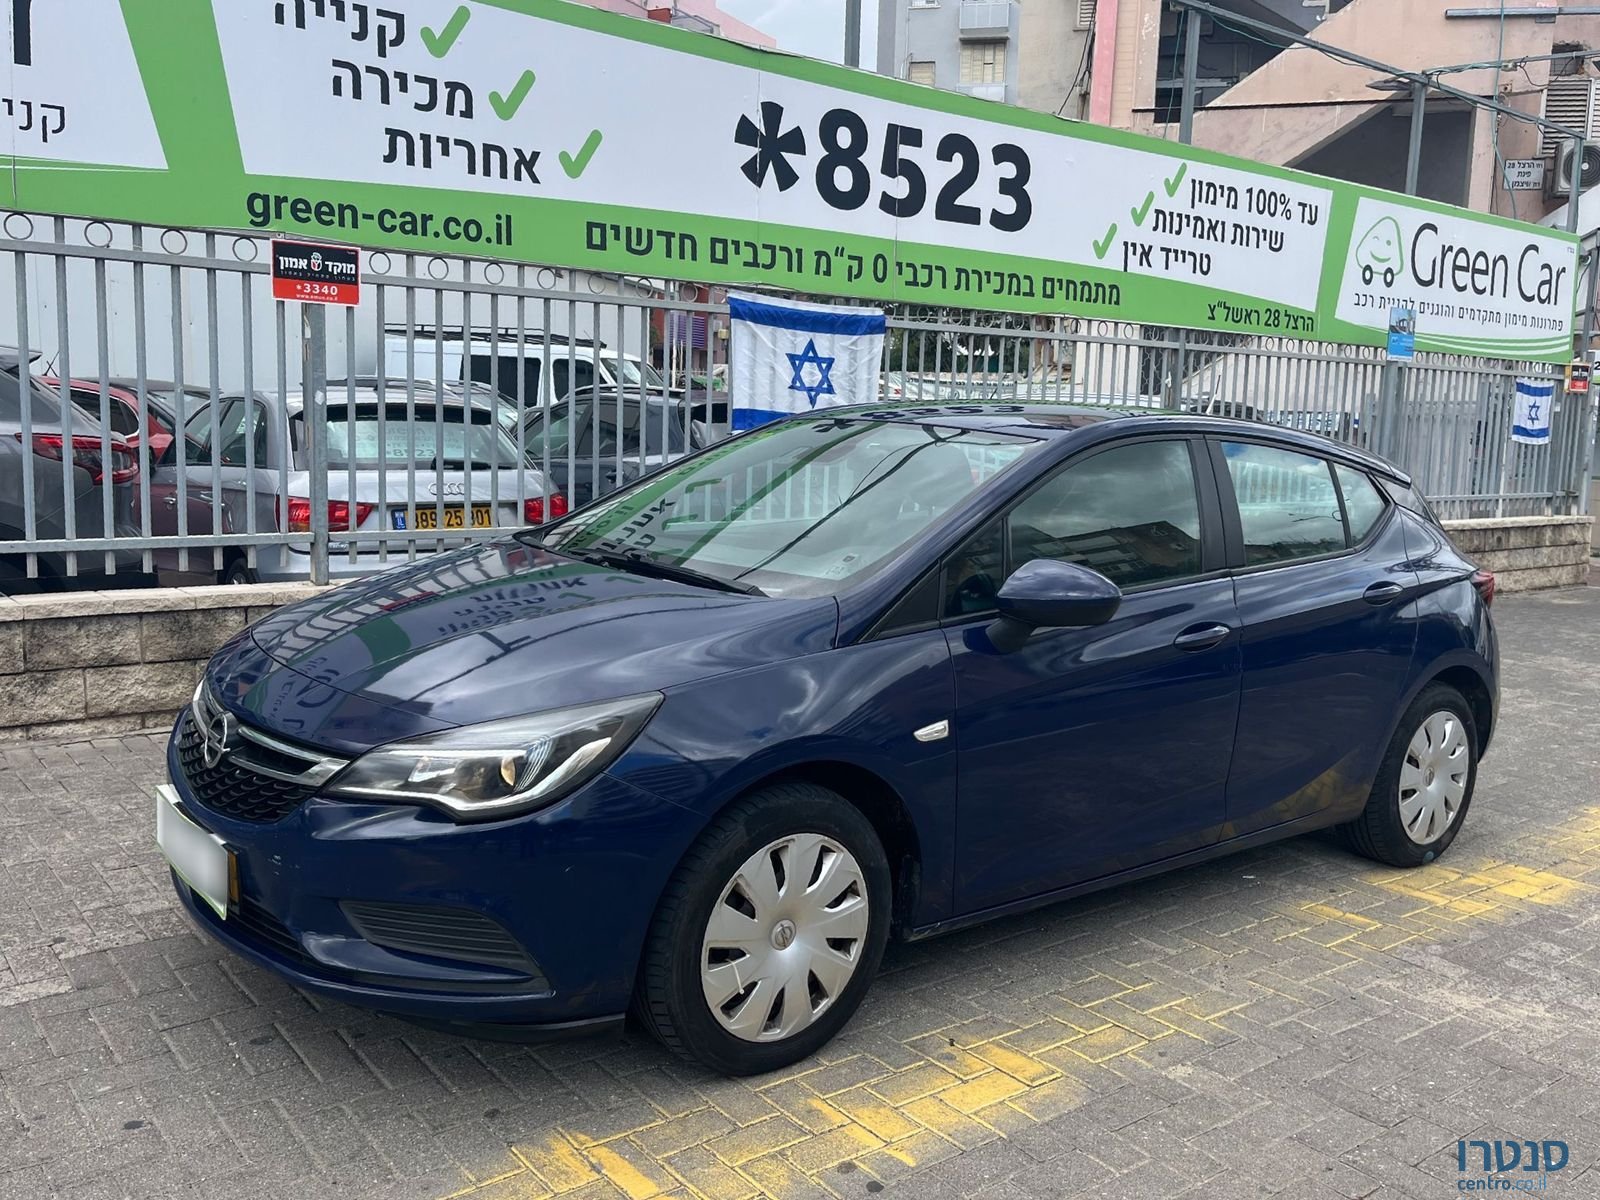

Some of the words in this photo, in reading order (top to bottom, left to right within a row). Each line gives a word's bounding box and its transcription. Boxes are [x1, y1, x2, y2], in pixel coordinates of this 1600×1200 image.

[275, 0, 405, 58] קנייה
[332, 58, 474, 119] מכירה
[383, 127, 541, 184] אחריות
[1191, 178, 1238, 209] מימון
[1246, 187, 1292, 221] 100%
[246, 191, 512, 246] green-car.co.il
[1152, 208, 1226, 242] ואמינות
[1297, 201, 1319, 225] עד
[585, 220, 698, 262] חדשים
[1231, 223, 1284, 252] שירות
[279, 256, 308, 270] אמון
[325, 261, 356, 275] מוקד
[709, 235, 803, 274] ורכבים
[872, 254, 888, 283] 0
[1123, 240, 1153, 272] אין
[1160, 246, 1211, 275] טרייד
[1411, 222, 1508, 298] Green
[1517, 244, 1566, 306] Car
[894, 259, 947, 290] רכבי
[956, 267, 1035, 298] במכירת
[1042, 277, 1121, 306] מתמחים
[1354, 292, 1374, 308] רכב
[1264, 308, 1281, 328] 28
[1284, 310, 1314, 332] הרצל
[1419, 303, 1454, 319] והוגנים
[1458, 307, 1502, 326] מתקדמים
[1504, 312, 1527, 329] מימון
[1530, 315, 1563, 332] פתרונות
[445, 510, 463, 527] 25
